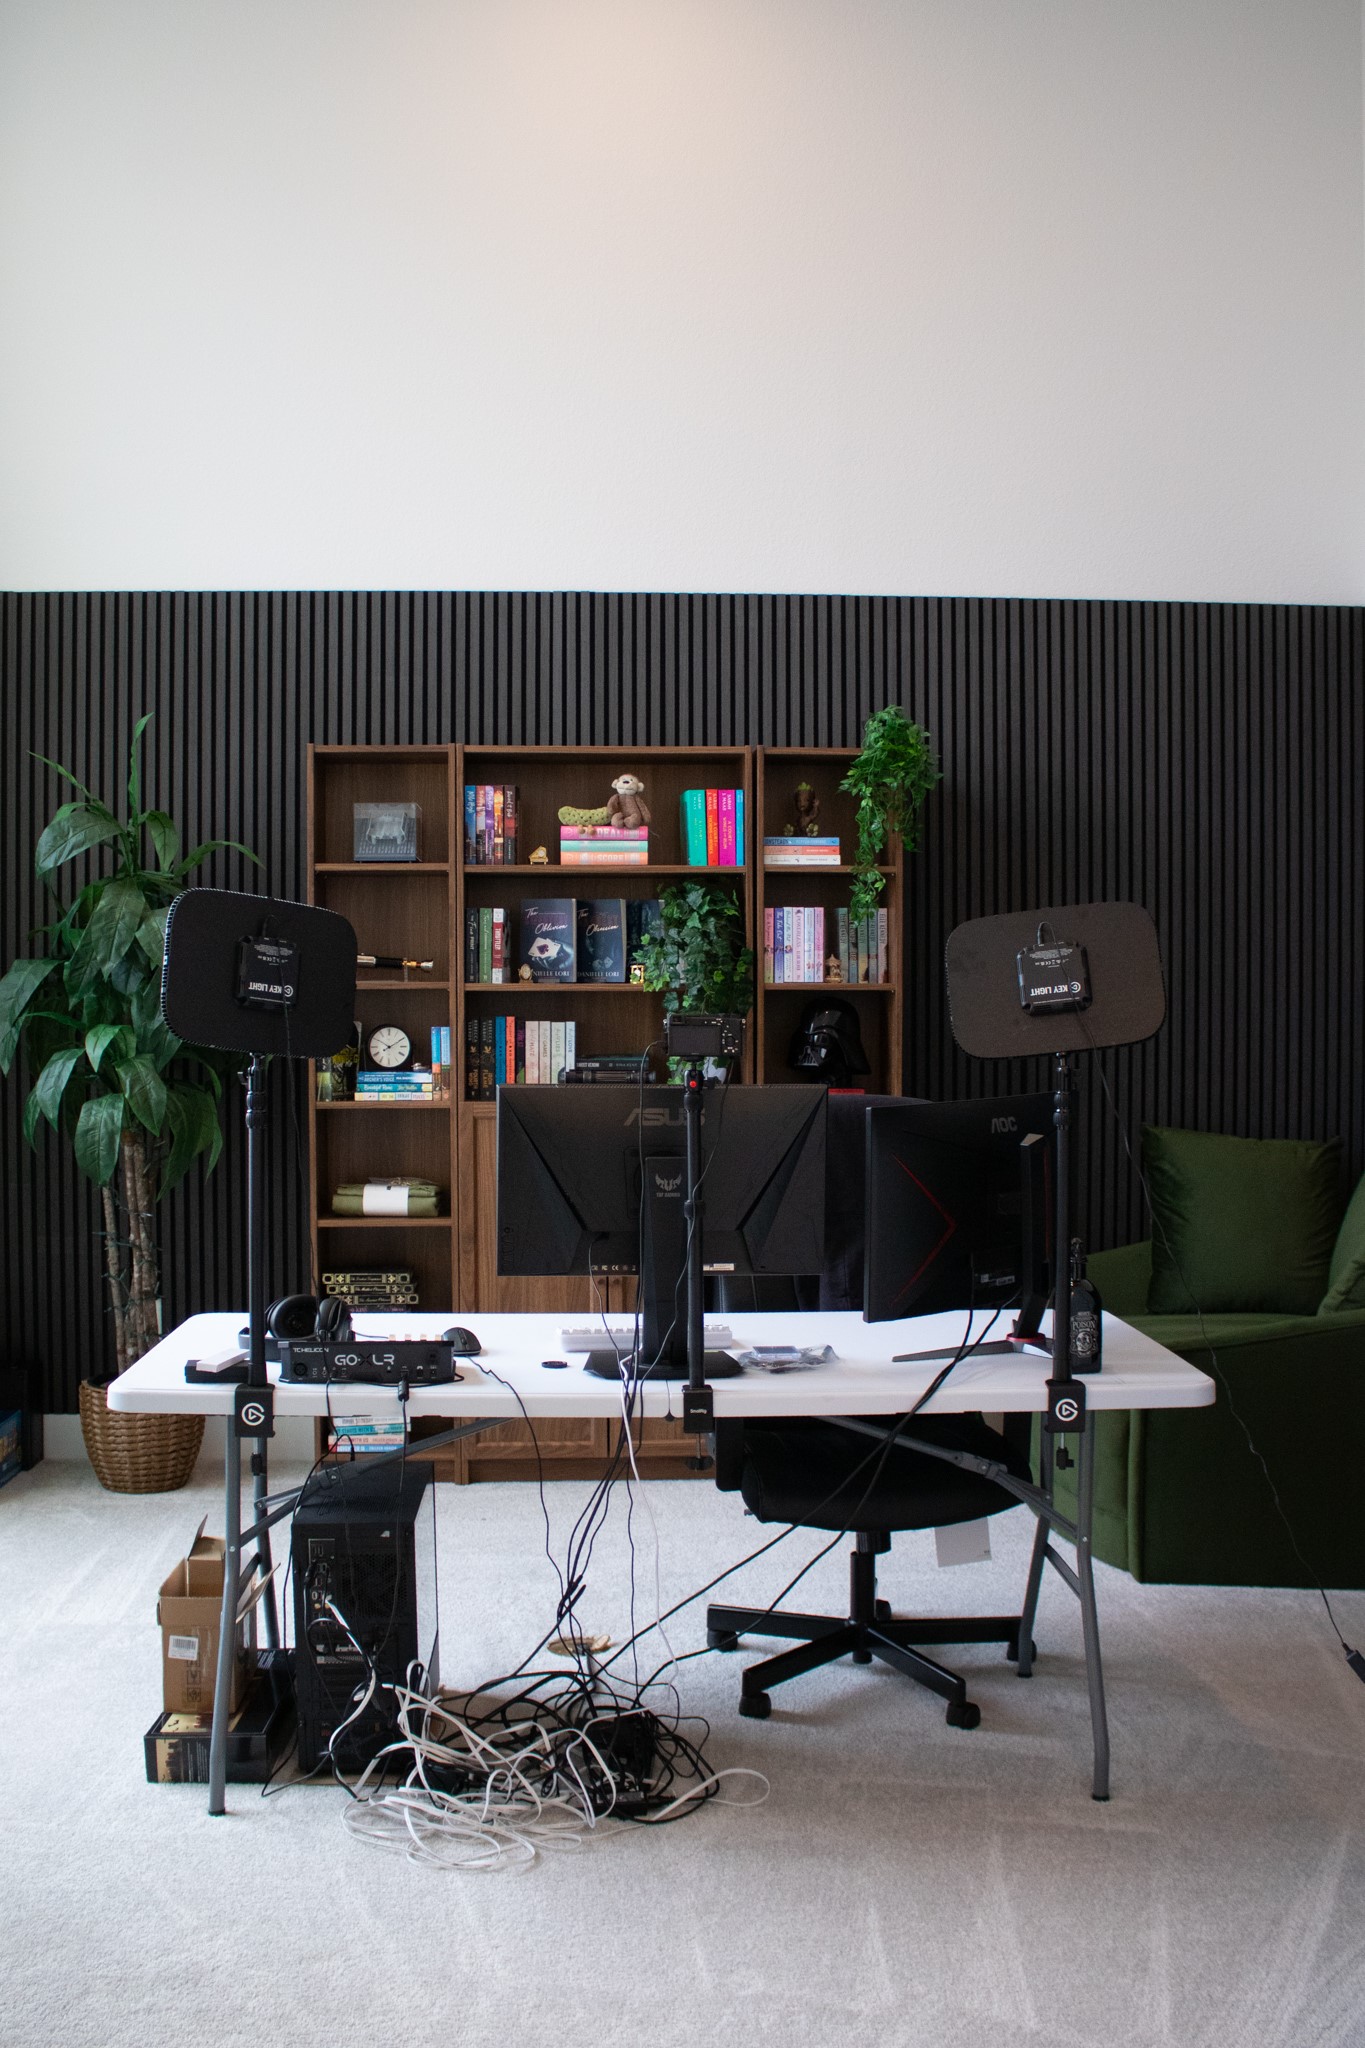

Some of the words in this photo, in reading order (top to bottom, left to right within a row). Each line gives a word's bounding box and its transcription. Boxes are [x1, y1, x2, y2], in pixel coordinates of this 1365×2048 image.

[525, 907, 539, 919] The
[535, 923, 568, 935] Oblivion
[586, 924, 619, 936] Obsession
[248, 982, 268, 992] LIGHT
[269, 985, 282, 994] KEY
[1030, 986, 1052, 996] LIGHT
[1054, 985, 1068, 994] KEY
[624, 1108, 705, 1126] ASU
[991, 1116, 1017, 1134] AOC
[1073, 1320, 1095, 1331] POISON
